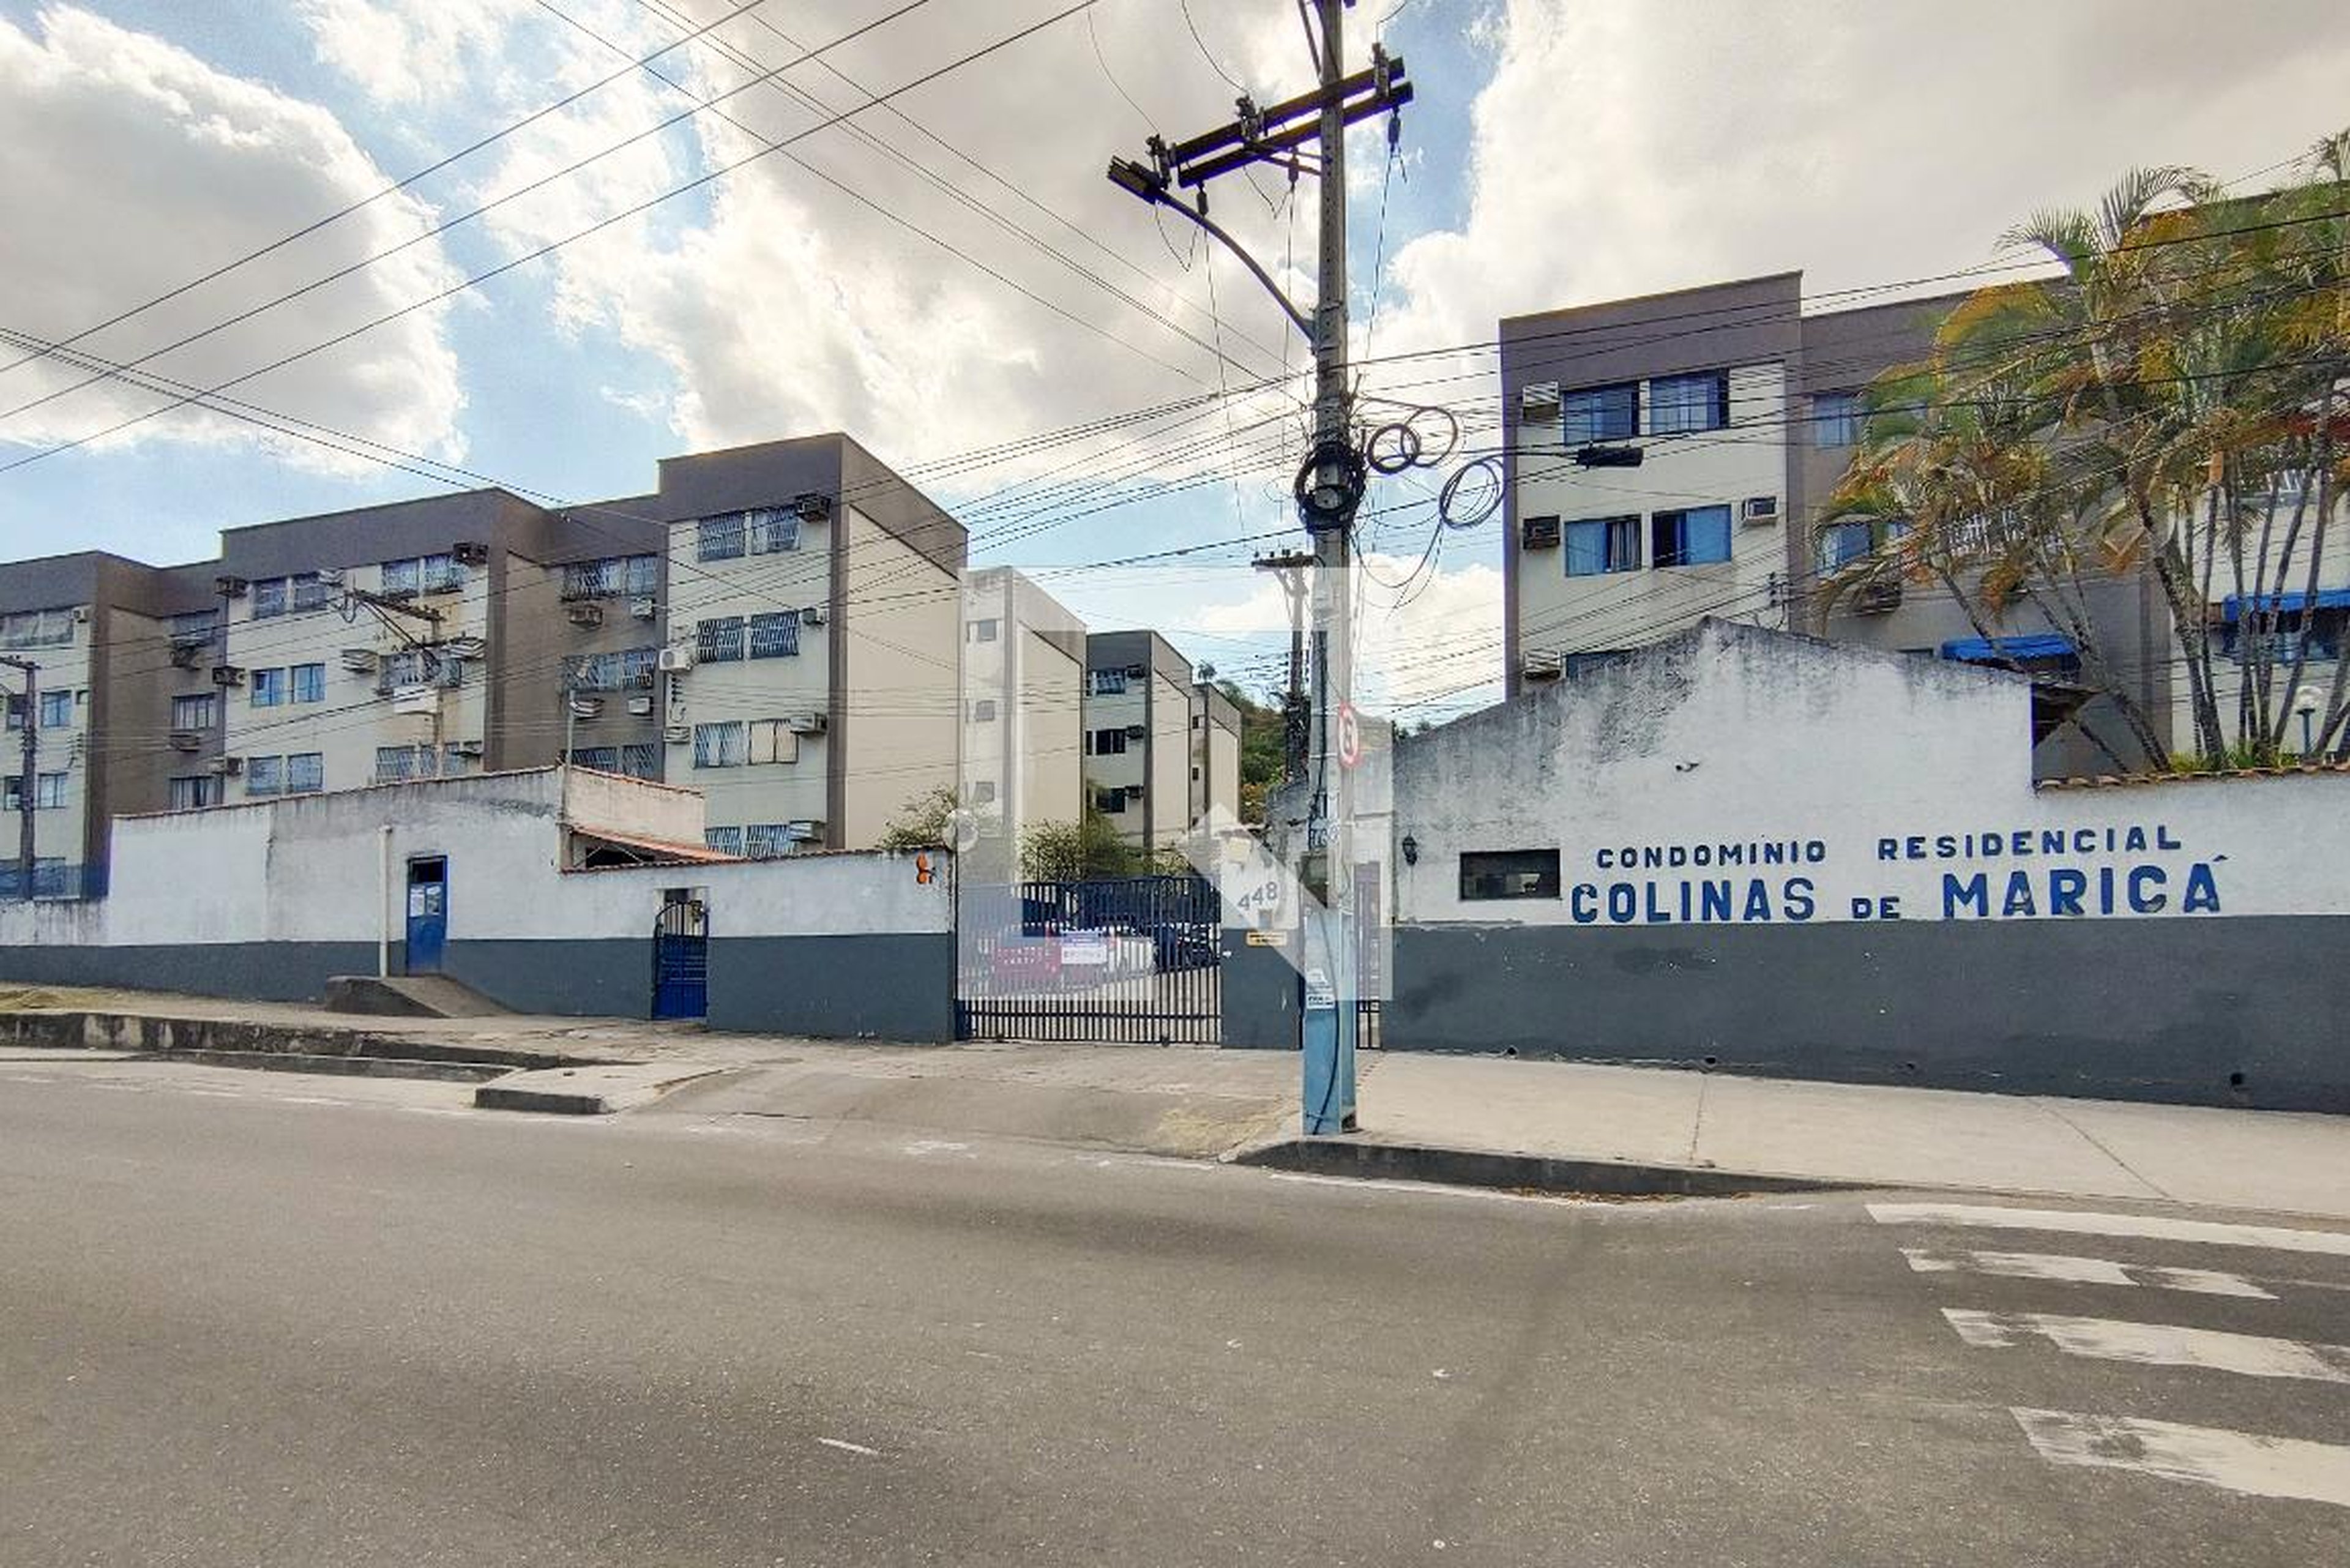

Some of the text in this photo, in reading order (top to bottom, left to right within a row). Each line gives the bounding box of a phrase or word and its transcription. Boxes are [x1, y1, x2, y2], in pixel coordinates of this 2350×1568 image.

[1878, 826, 2181, 861] RESIDENCIAL
[1237, 881, 1278, 911] 448
[1571, 855, 2228, 924] COLINAS DE MARICÁ
